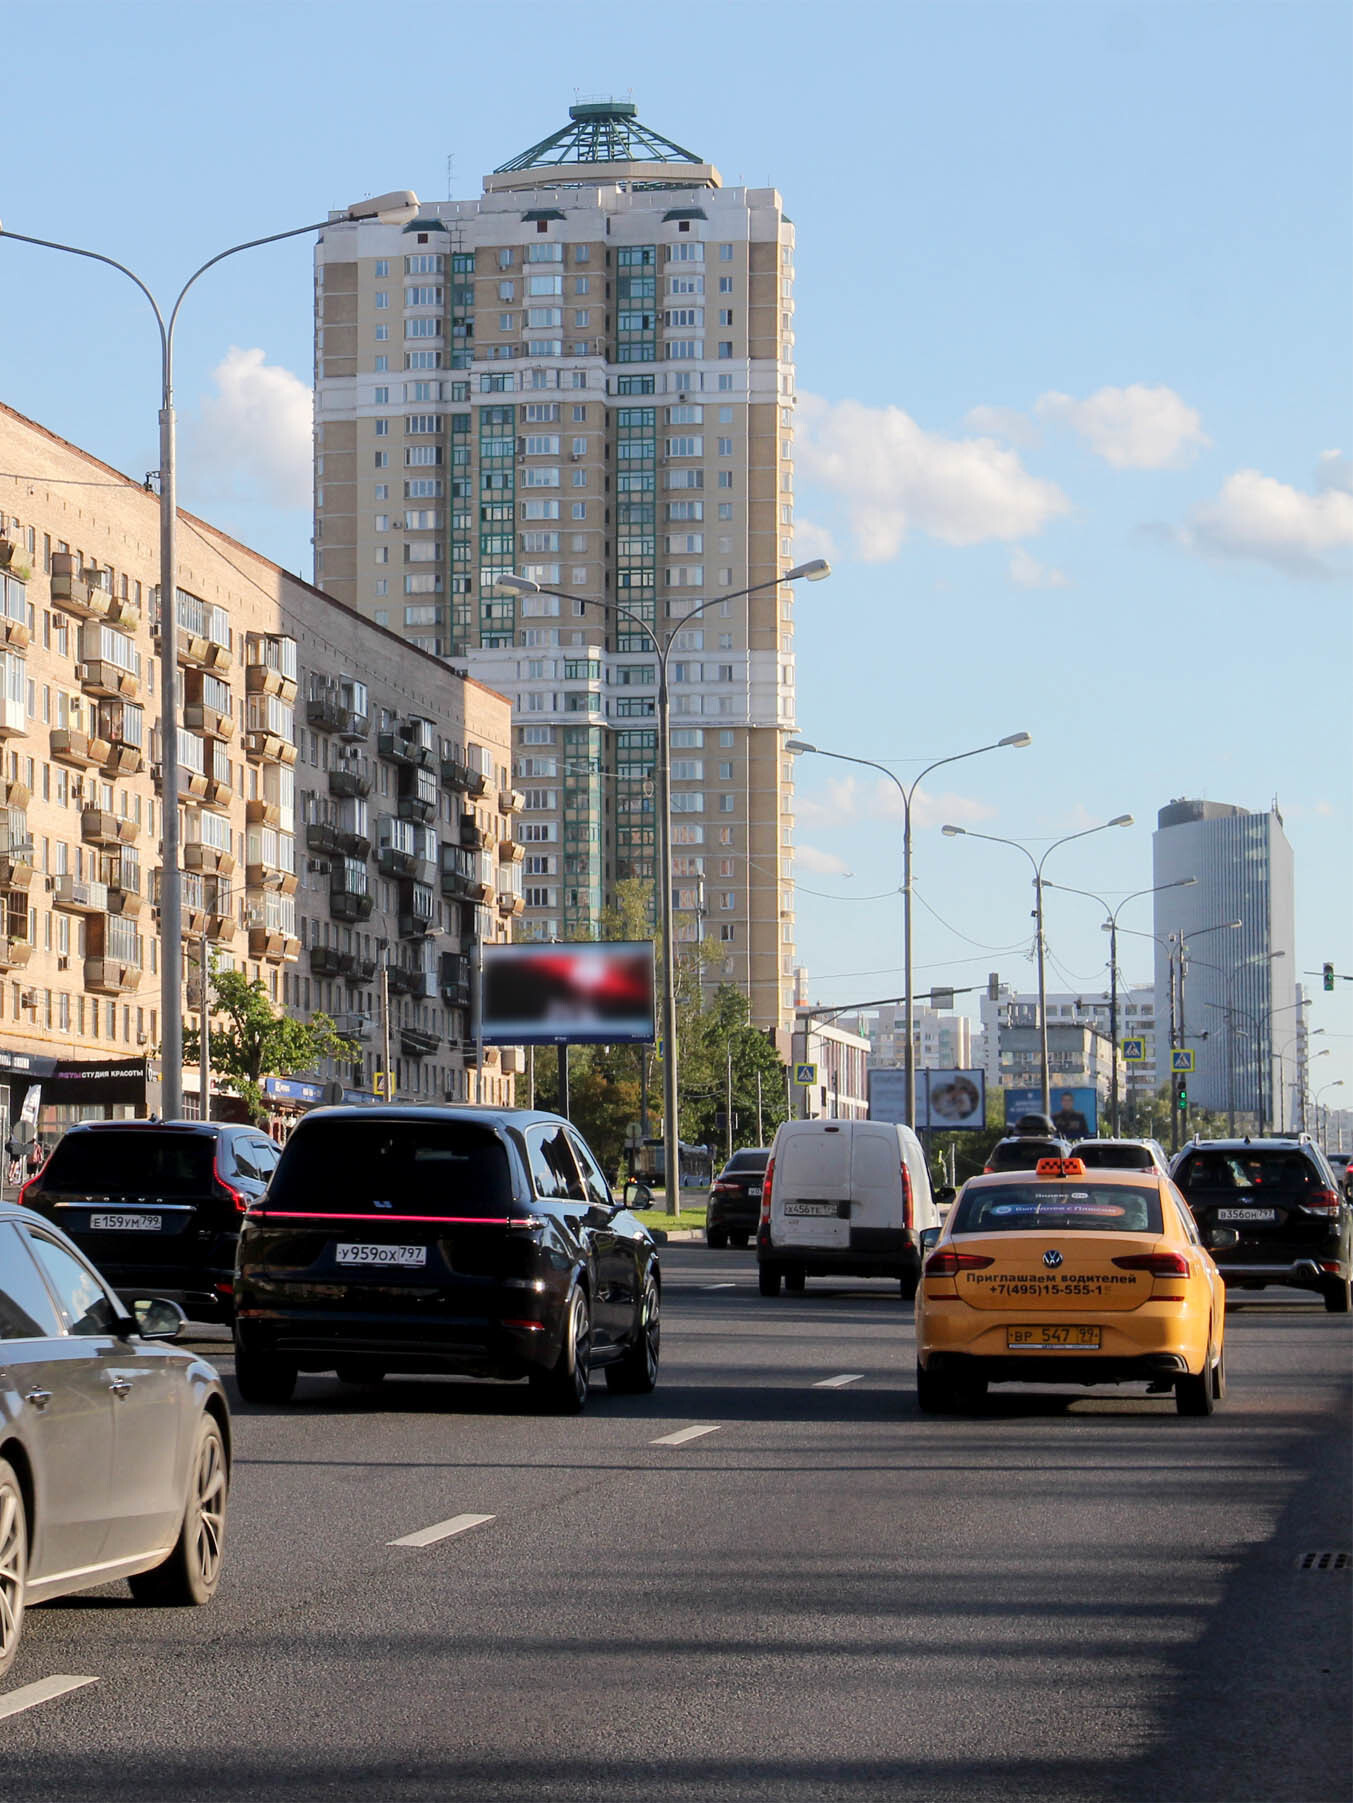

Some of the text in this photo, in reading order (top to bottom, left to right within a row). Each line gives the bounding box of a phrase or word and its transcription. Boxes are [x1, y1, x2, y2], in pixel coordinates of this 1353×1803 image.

[81, 1071, 109, 1079] СТУДИЯ
[110, 1069, 144, 1078] КРАСОТЫ
[966, 1272, 1137, 1284] Приглашаем водителей
[1041, 1328, 1070, 1343] 547
